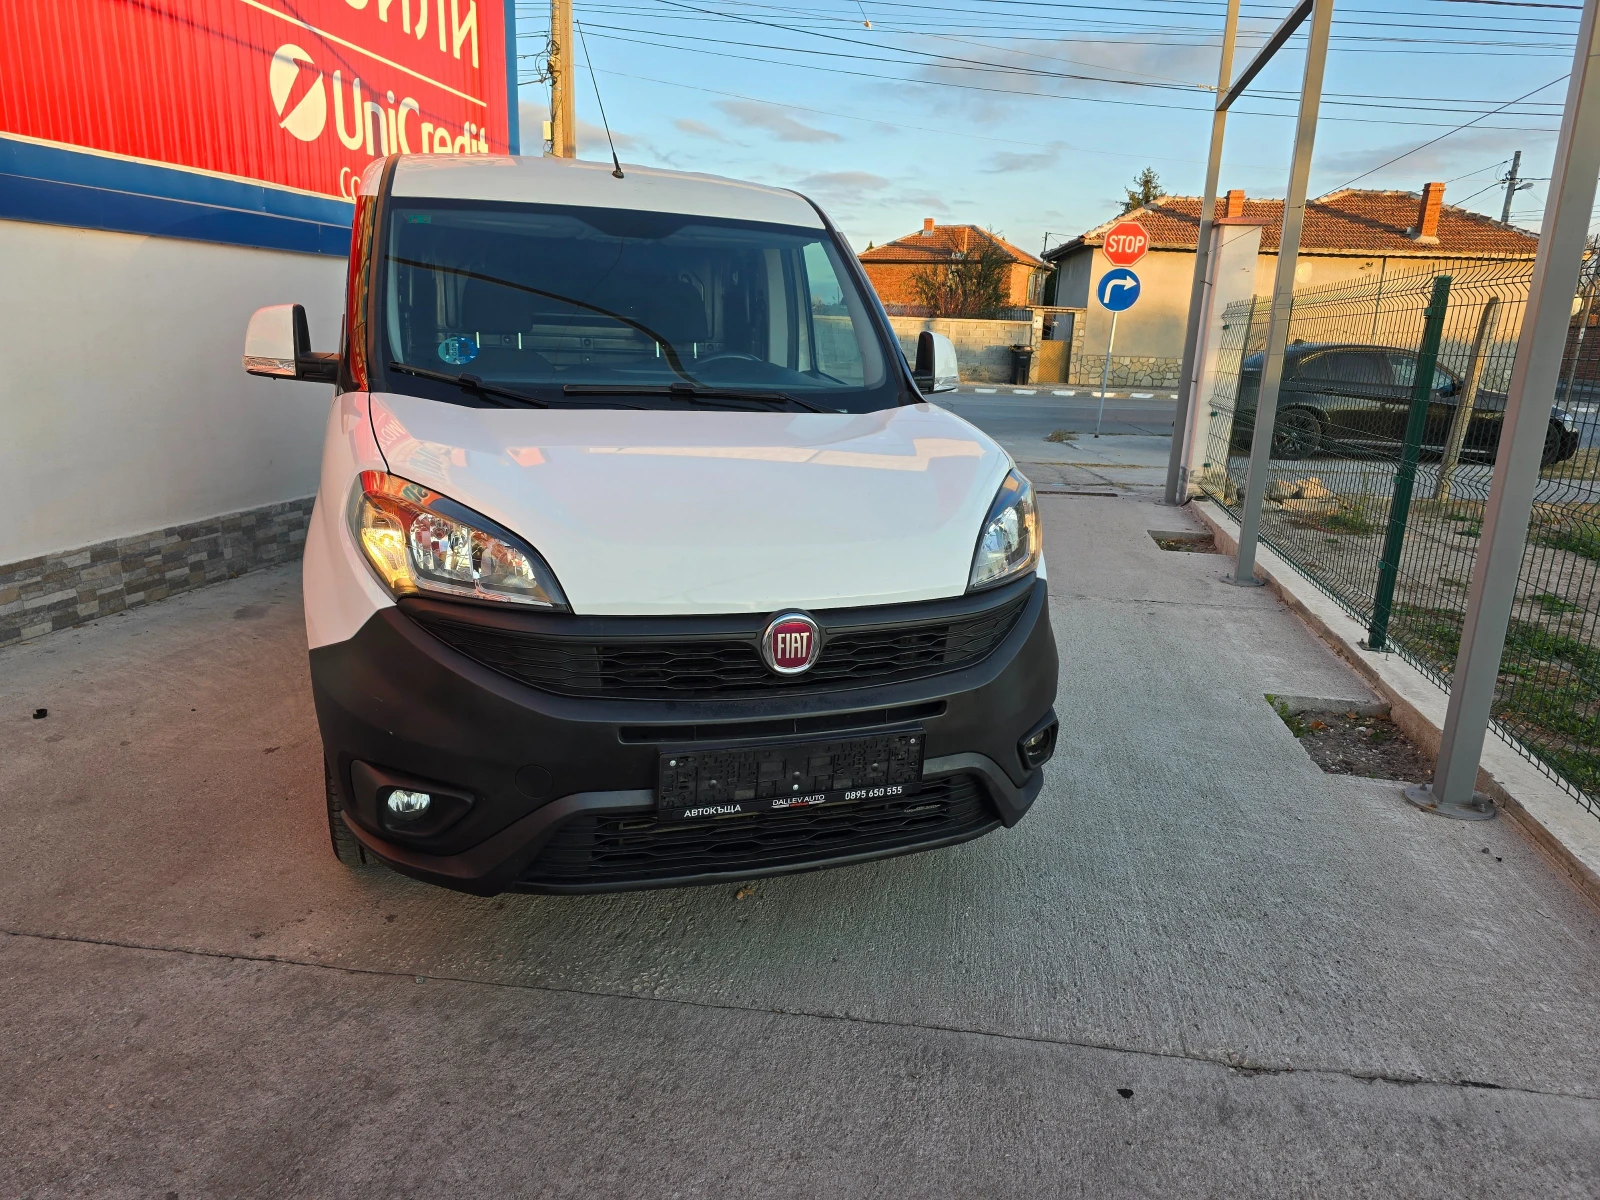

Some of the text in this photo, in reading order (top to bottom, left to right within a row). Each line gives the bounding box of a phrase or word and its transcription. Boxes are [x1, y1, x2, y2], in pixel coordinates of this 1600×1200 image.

[1108, 235, 1145, 253] STOP
[777, 632, 810, 659] FIAT
[772, 794, 825, 806] DALLEV AUTO
[845, 785, 903, 800] 0895 650 555
[683, 804, 742, 818] АВТОКЪЩА
